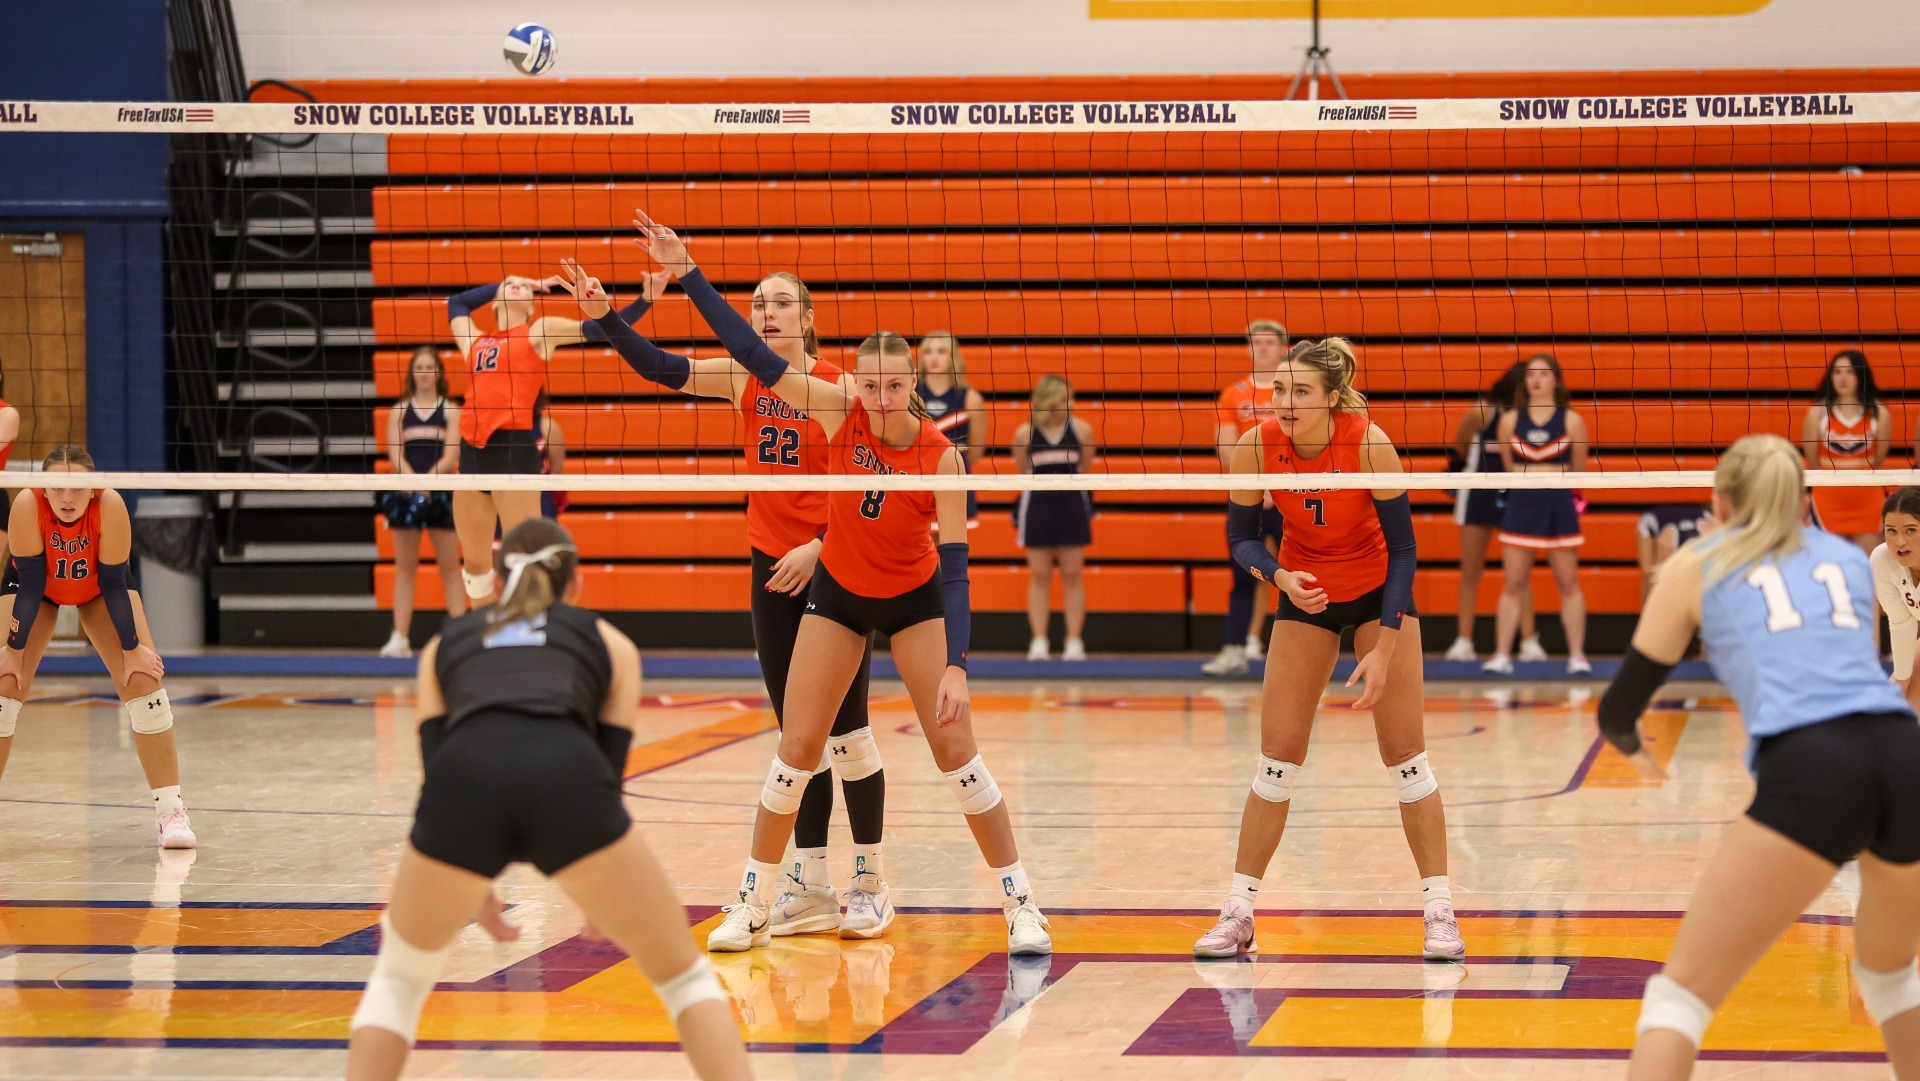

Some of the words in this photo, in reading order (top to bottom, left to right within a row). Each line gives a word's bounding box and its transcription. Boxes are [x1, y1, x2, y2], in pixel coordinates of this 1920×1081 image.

[117, 107, 184, 123] FreeTaxUSA
[293, 105, 362, 126] SNOW
[369, 105, 475, 126] COLLEGE
[482, 105, 634, 126] VOLLEYBALL
[714, 108, 781, 124] FreeTaxUSA
[891, 105, 960, 126] SNOW
[968, 104, 1074, 125] COLLEGE
[1082, 103, 1236, 124] VOLLEYBALL
[1318, 105, 1387, 121] FreeTaxUSA
[1499, 99, 1570, 121] SNOW
[1578, 97, 1687, 120] COLLEGE
[1695, 94, 1854, 118] VOLLEYBALL
[473, 345, 501, 374] 12
[757, 424, 801, 467] 22
[859, 490, 887, 521] 8
[1302, 497, 1329, 527] 7
[54, 557, 90, 581] 16
[1746, 561, 1861, 635] 11
